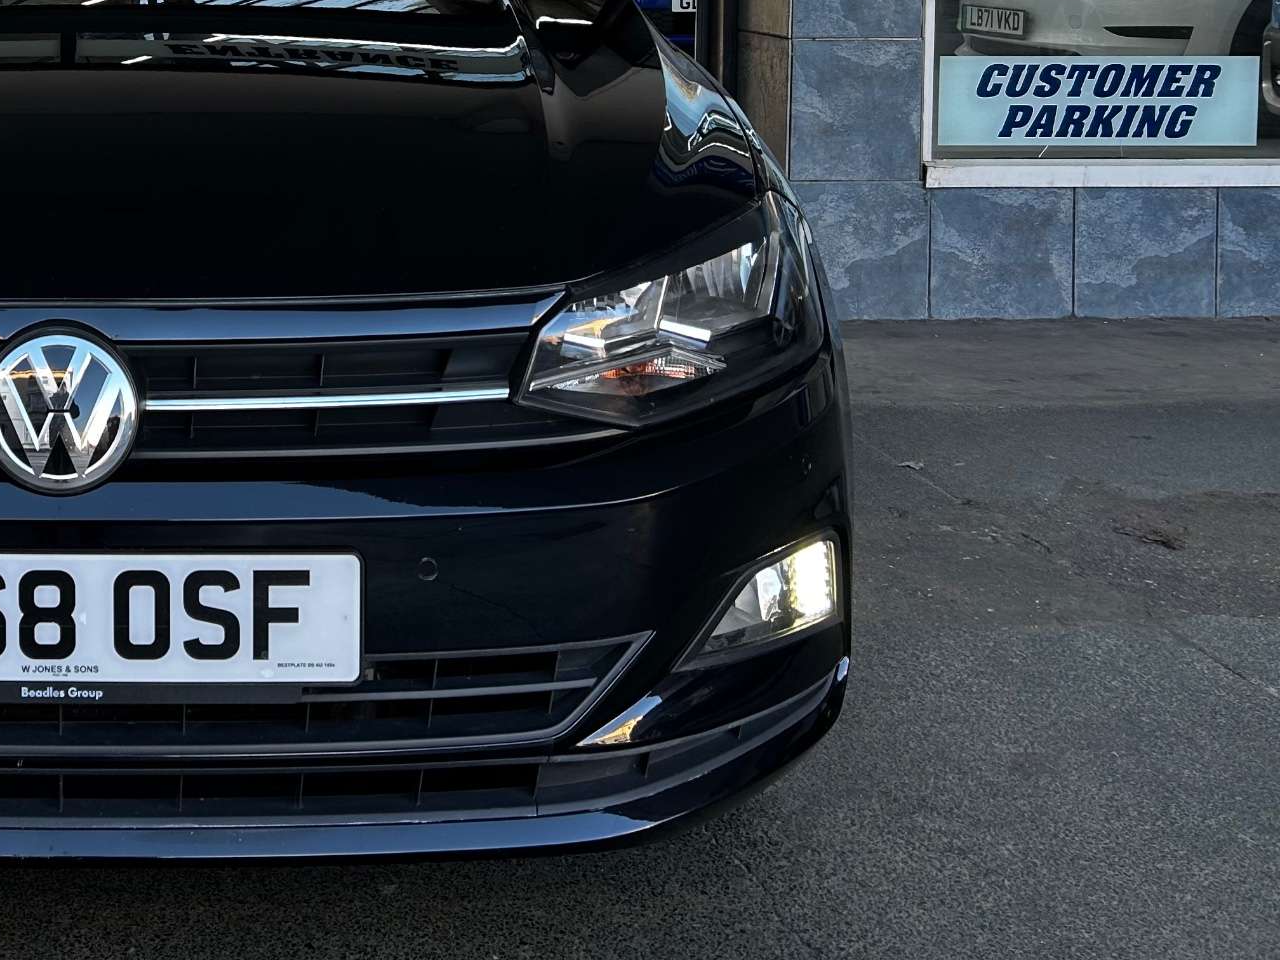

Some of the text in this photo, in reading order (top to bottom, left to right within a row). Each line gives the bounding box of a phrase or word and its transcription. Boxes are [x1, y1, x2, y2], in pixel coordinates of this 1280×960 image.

[970, 7, 1020, 31] LB71 VKD
[976, 63, 1222, 98] CUSTOMER
[997, 104, 1198, 139] PARKING
[113, 569, 310, 660] OSF
[21, 665, 99, 673] W JONES & SONS
[21, 686, 104, 700] Beadles Group
